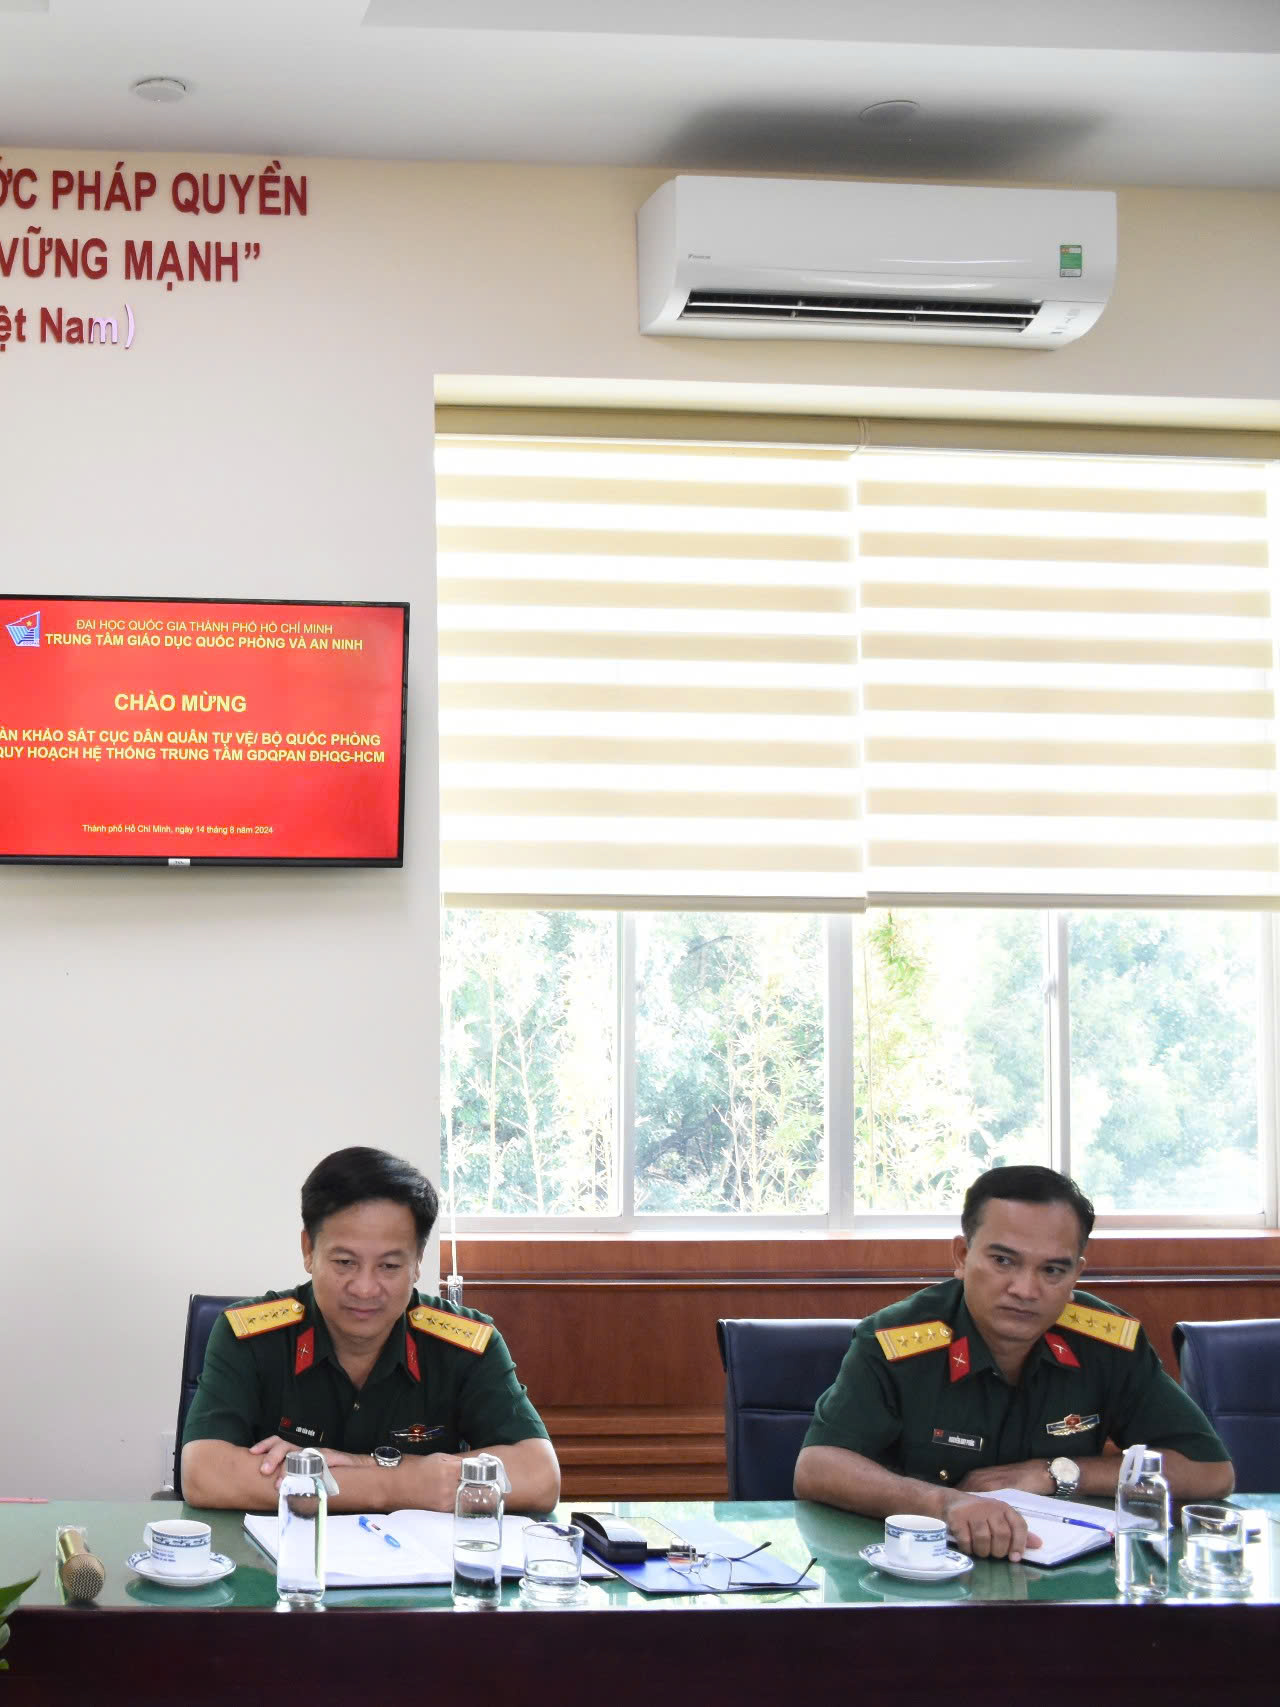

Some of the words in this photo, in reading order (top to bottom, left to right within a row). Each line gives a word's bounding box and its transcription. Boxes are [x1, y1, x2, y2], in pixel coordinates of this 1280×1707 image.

[52, 162, 157, 212] PHÁP
[171, 162, 307, 216] QUYỀN
[76, 620, 96, 632] ĐẠI
[99, 620, 125, 632] HỌC
[128, 618, 164, 631] QUỐC
[166, 620, 186, 631] GIA
[280, 622, 300, 634] CHÍ
[304, 624, 333, 634] MINH
[46, 634, 92, 646] TRUNG
[96, 632, 124, 646] TÂM
[128, 633, 160, 646] GIÁO
[164, 636, 192, 649] DỤC
[238, 634, 286, 649] PHÒNG
[289, 636, 307, 649] VÀ
[310, 639, 328, 650] AN
[332, 639, 363, 650] NINH
[114, 690, 176, 712] CHÀO
[181, 691, 248, 713] MỪNG
[22, 728, 64, 742] KHẢO
[67, 729, 96, 742] SÁT
[99, 730, 129, 746] CỤC
[134, 728, 164, 743] DÂN
[167, 729, 208, 745] QUÂN
[212, 732, 233, 747] TỰ
[262, 731, 282, 747] BỘ
[330, 732, 381, 746] PHÒNG
[28, 746, 79, 761] HOẠCH
[82, 746, 102, 762] HỆ
[160, 748, 209, 760] TRUNG
[246, 749, 306, 762] GDQPAN
[310, 750, 386, 763] ĐHQG-HCM
[254, 826, 274, 834] 2024
